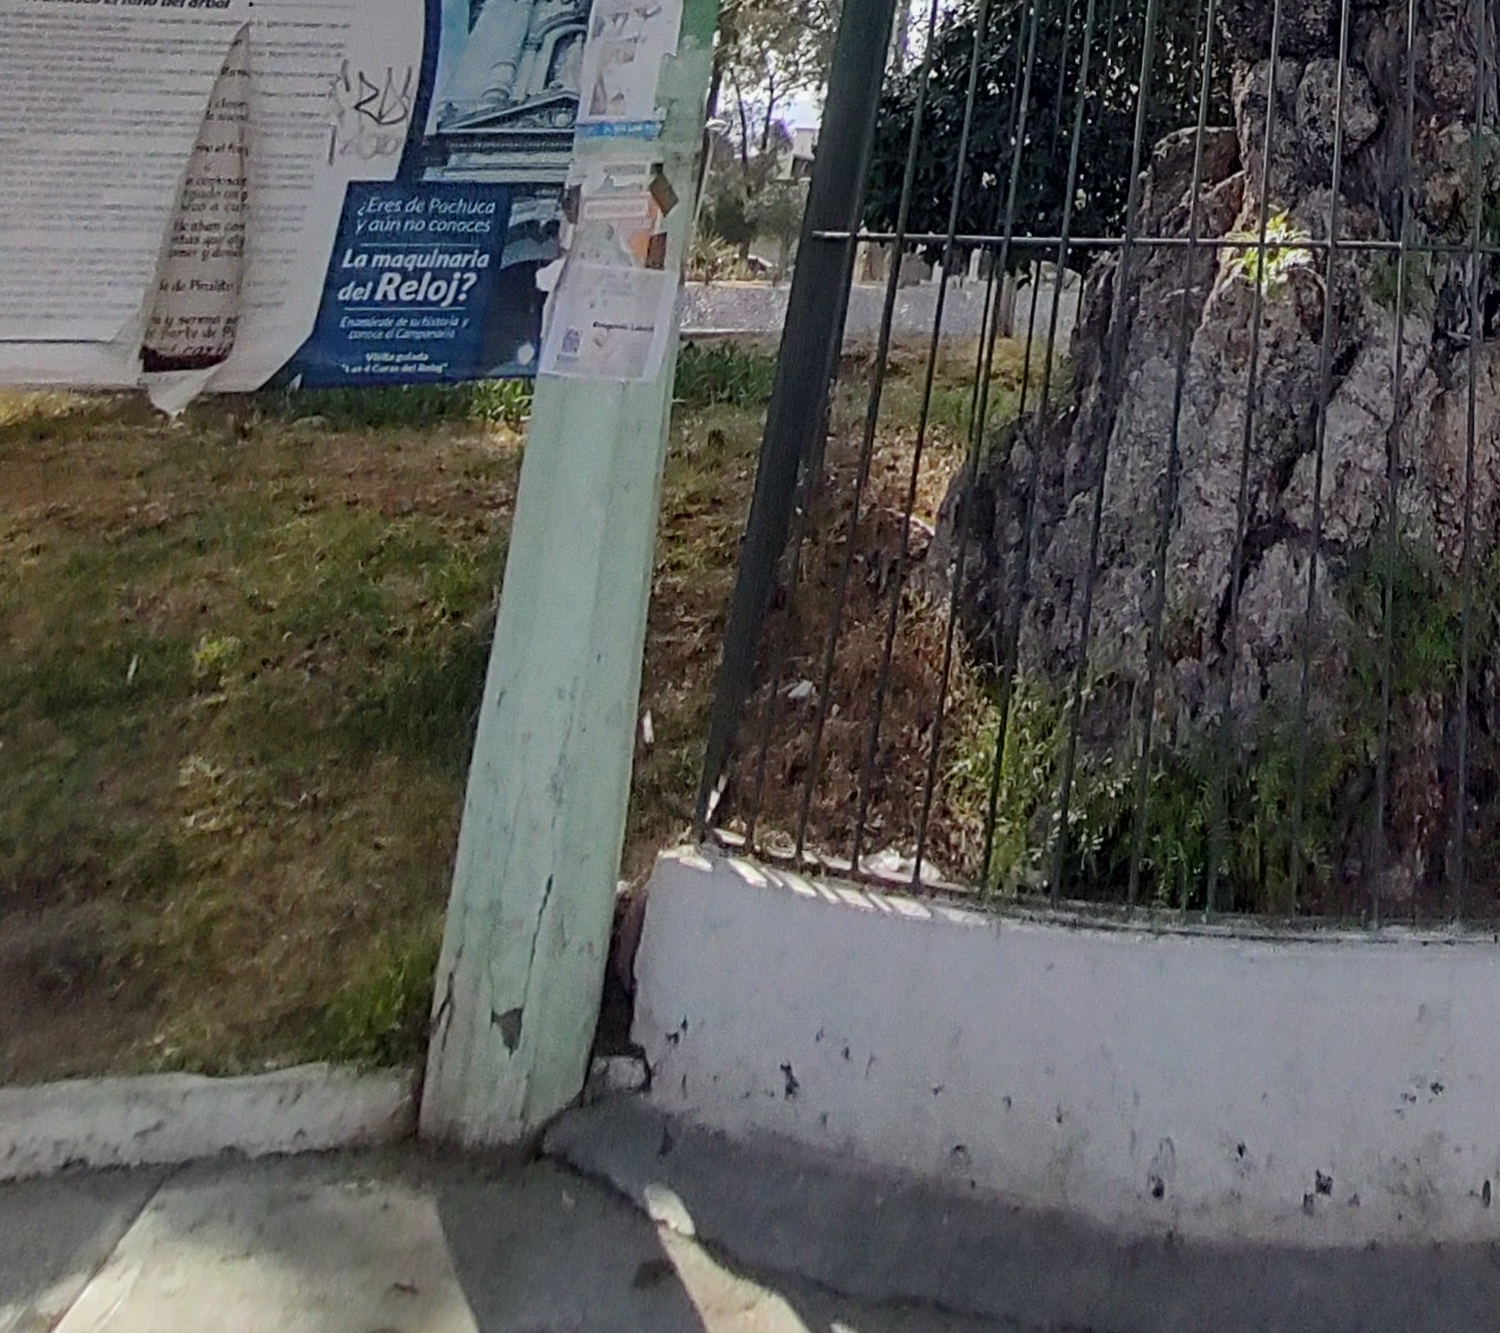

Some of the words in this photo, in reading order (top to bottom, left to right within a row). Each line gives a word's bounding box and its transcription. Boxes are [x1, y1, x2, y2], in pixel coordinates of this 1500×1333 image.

[357, 197, 402, 216] ¿Eres
[405, 197, 425, 214] de
[428, 197, 496, 215] Pachuca
[356, 219, 368, 234] y
[368, 216, 401, 232] aún
[403, 219, 425, 232] no
[428, 219, 491, 233] conoces
[342, 248, 367, 268] La
[371, 248, 490, 272] maquinaria
[337, 280, 374, 301] del
[374, 271, 478, 308] Reloj?
